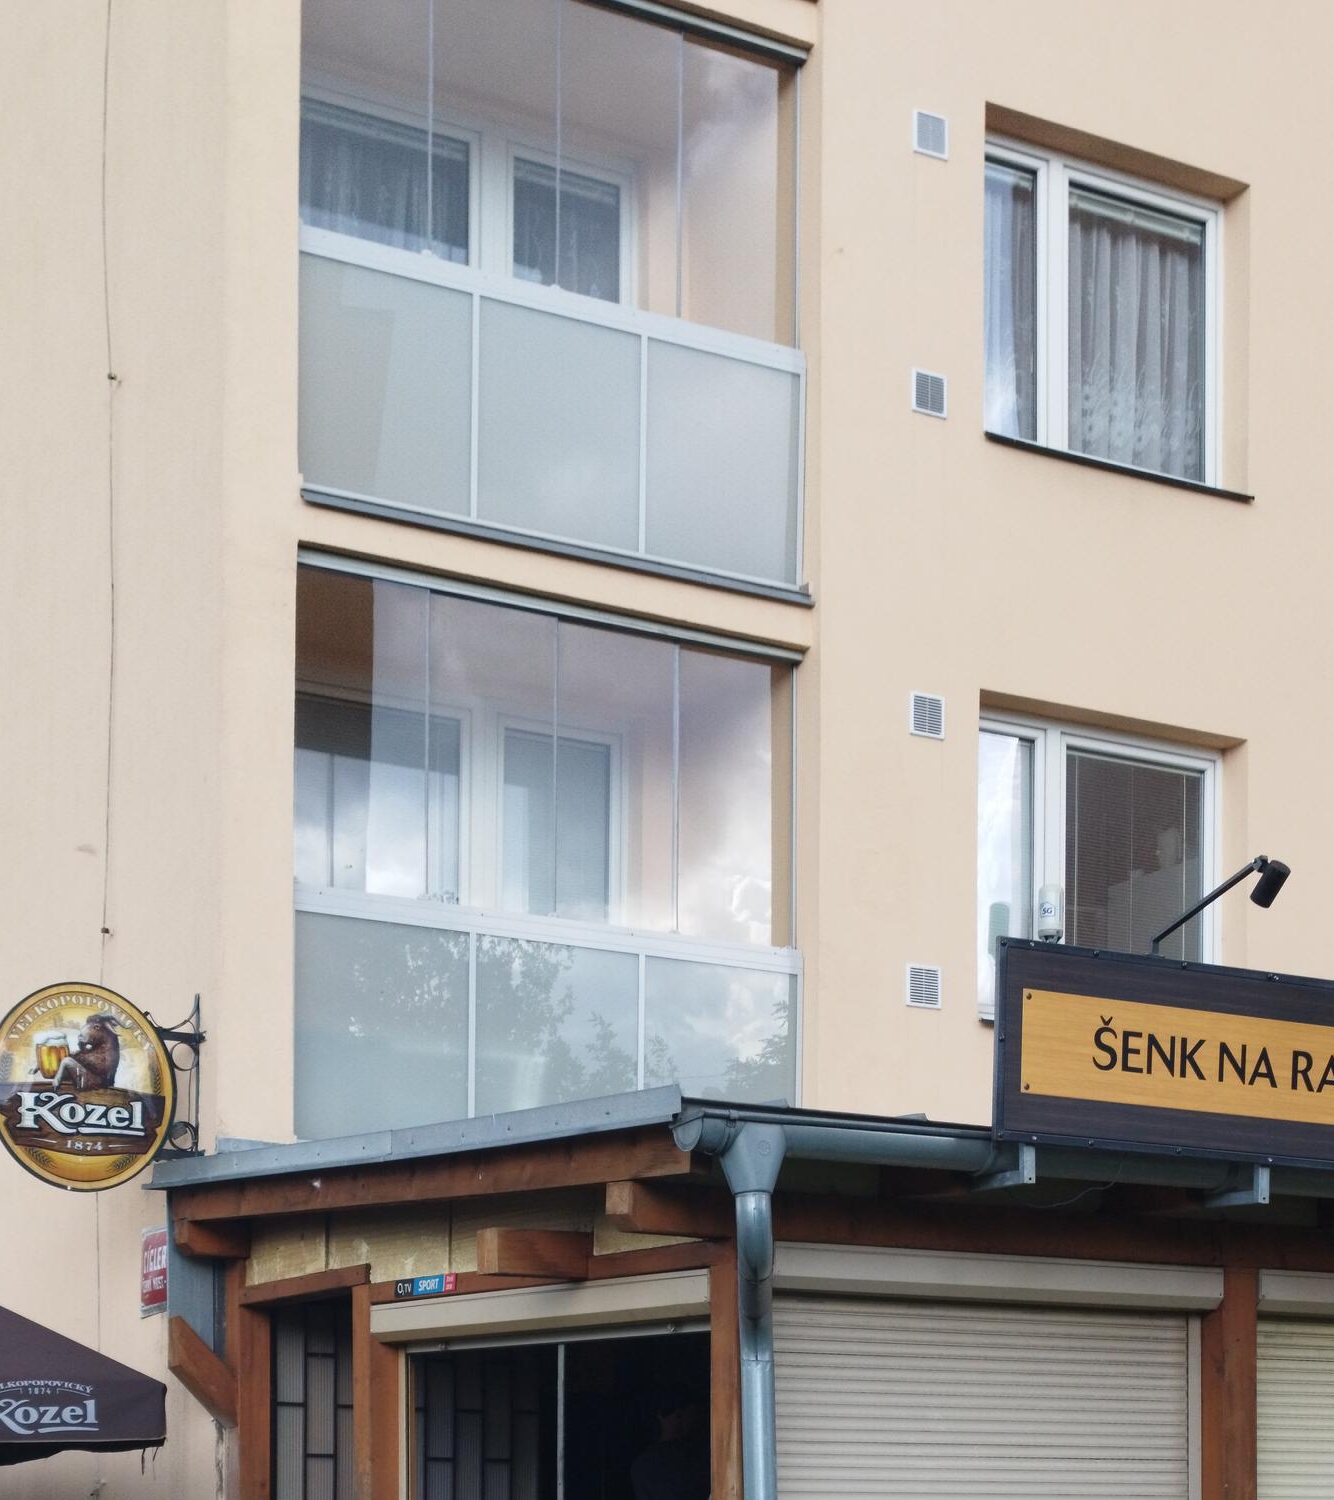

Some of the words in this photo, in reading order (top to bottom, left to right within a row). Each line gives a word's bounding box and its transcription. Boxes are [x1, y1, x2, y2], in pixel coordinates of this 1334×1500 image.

[1092, 1015, 1206, 1081] ŠENK
[1218, 1041, 1278, 1089] NA
[16, 1091, 145, 1136] Kozel
[66, 1139, 104, 1151] 1874
[418, 1279, 439, 1291] SPORT
